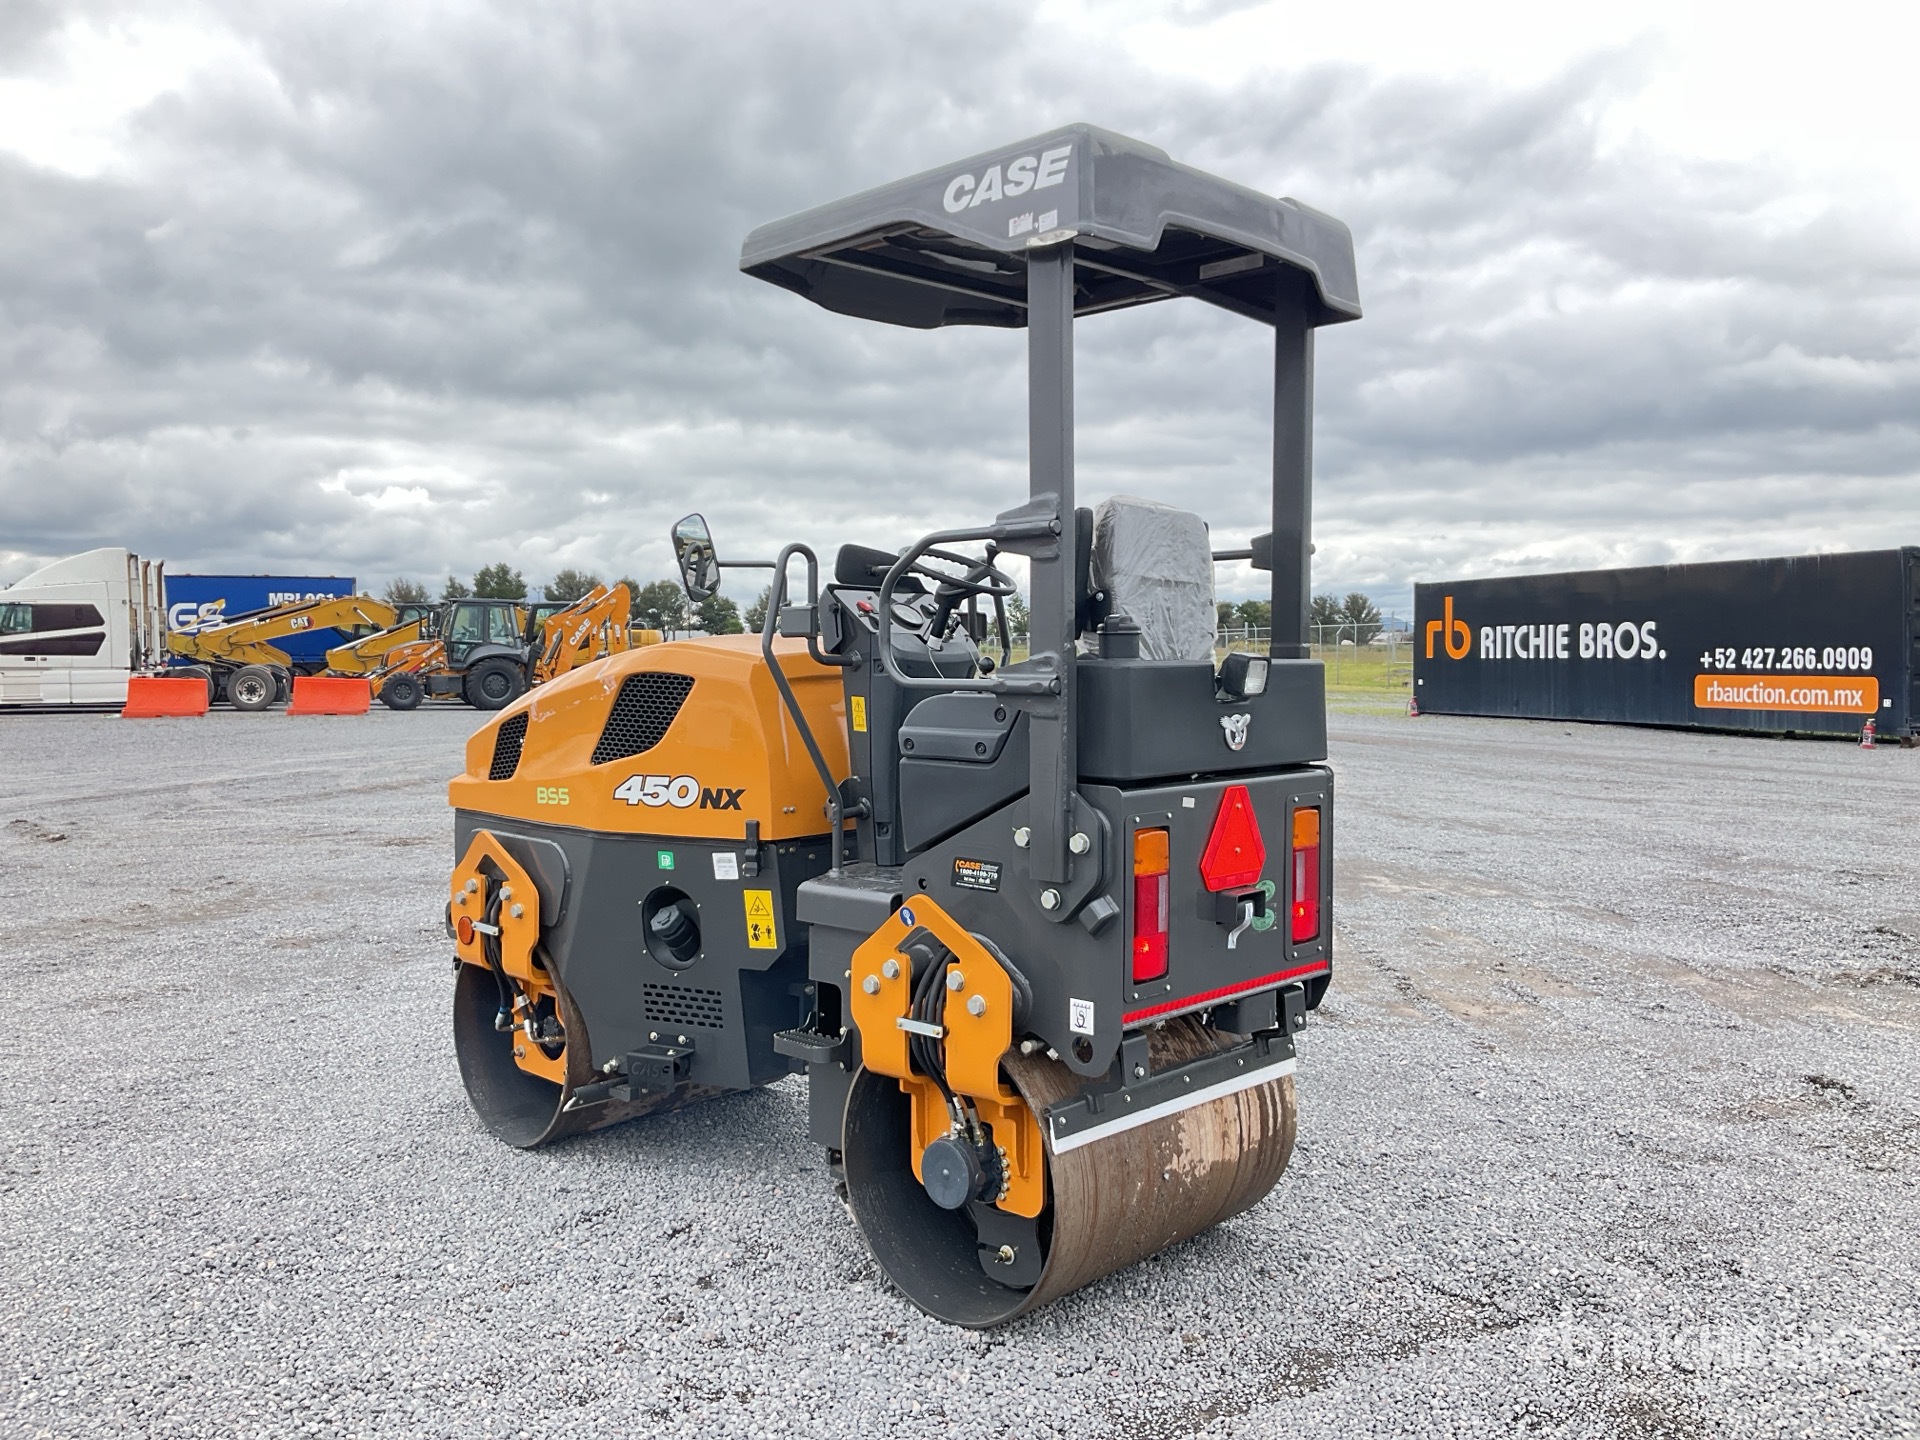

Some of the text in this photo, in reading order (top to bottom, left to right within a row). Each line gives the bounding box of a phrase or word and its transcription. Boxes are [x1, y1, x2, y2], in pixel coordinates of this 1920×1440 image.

[943, 145, 1072, 213] CASE
[290, 616, 309, 629] CAT
[569, 617, 592, 646] CASE
[1426, 596, 1667, 660] rb RITCHIE BROS.
[1700, 647, 1873, 669] +52 427.266.0909
[1707, 681, 1863, 706] rbauction.com.mx
[536, 786, 570, 805] BS5
[959, 860, 981, 869] CASE
